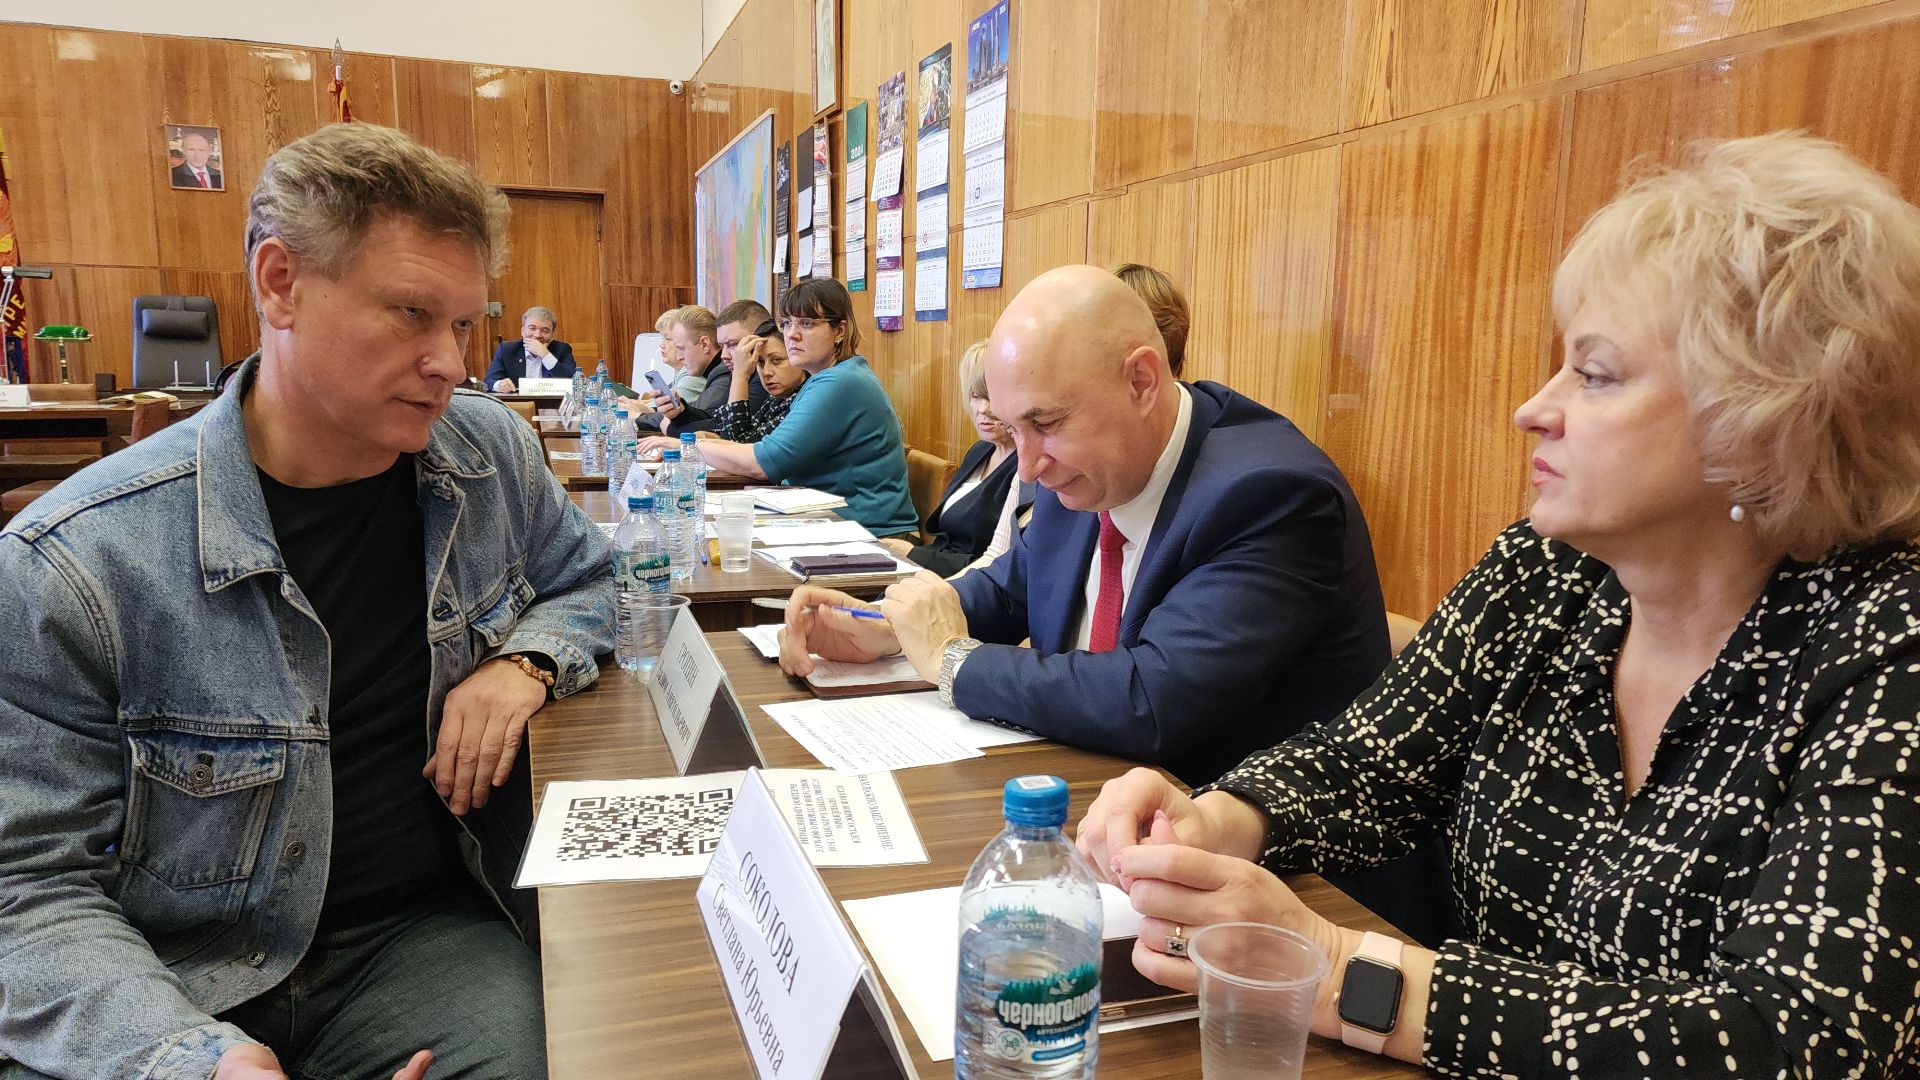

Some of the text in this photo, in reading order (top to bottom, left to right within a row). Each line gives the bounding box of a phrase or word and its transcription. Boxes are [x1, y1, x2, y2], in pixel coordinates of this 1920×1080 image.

[712, 883, 785, 1076] Светлана Юрьевна
[738, 850, 801, 996] СОКОЛОВА
